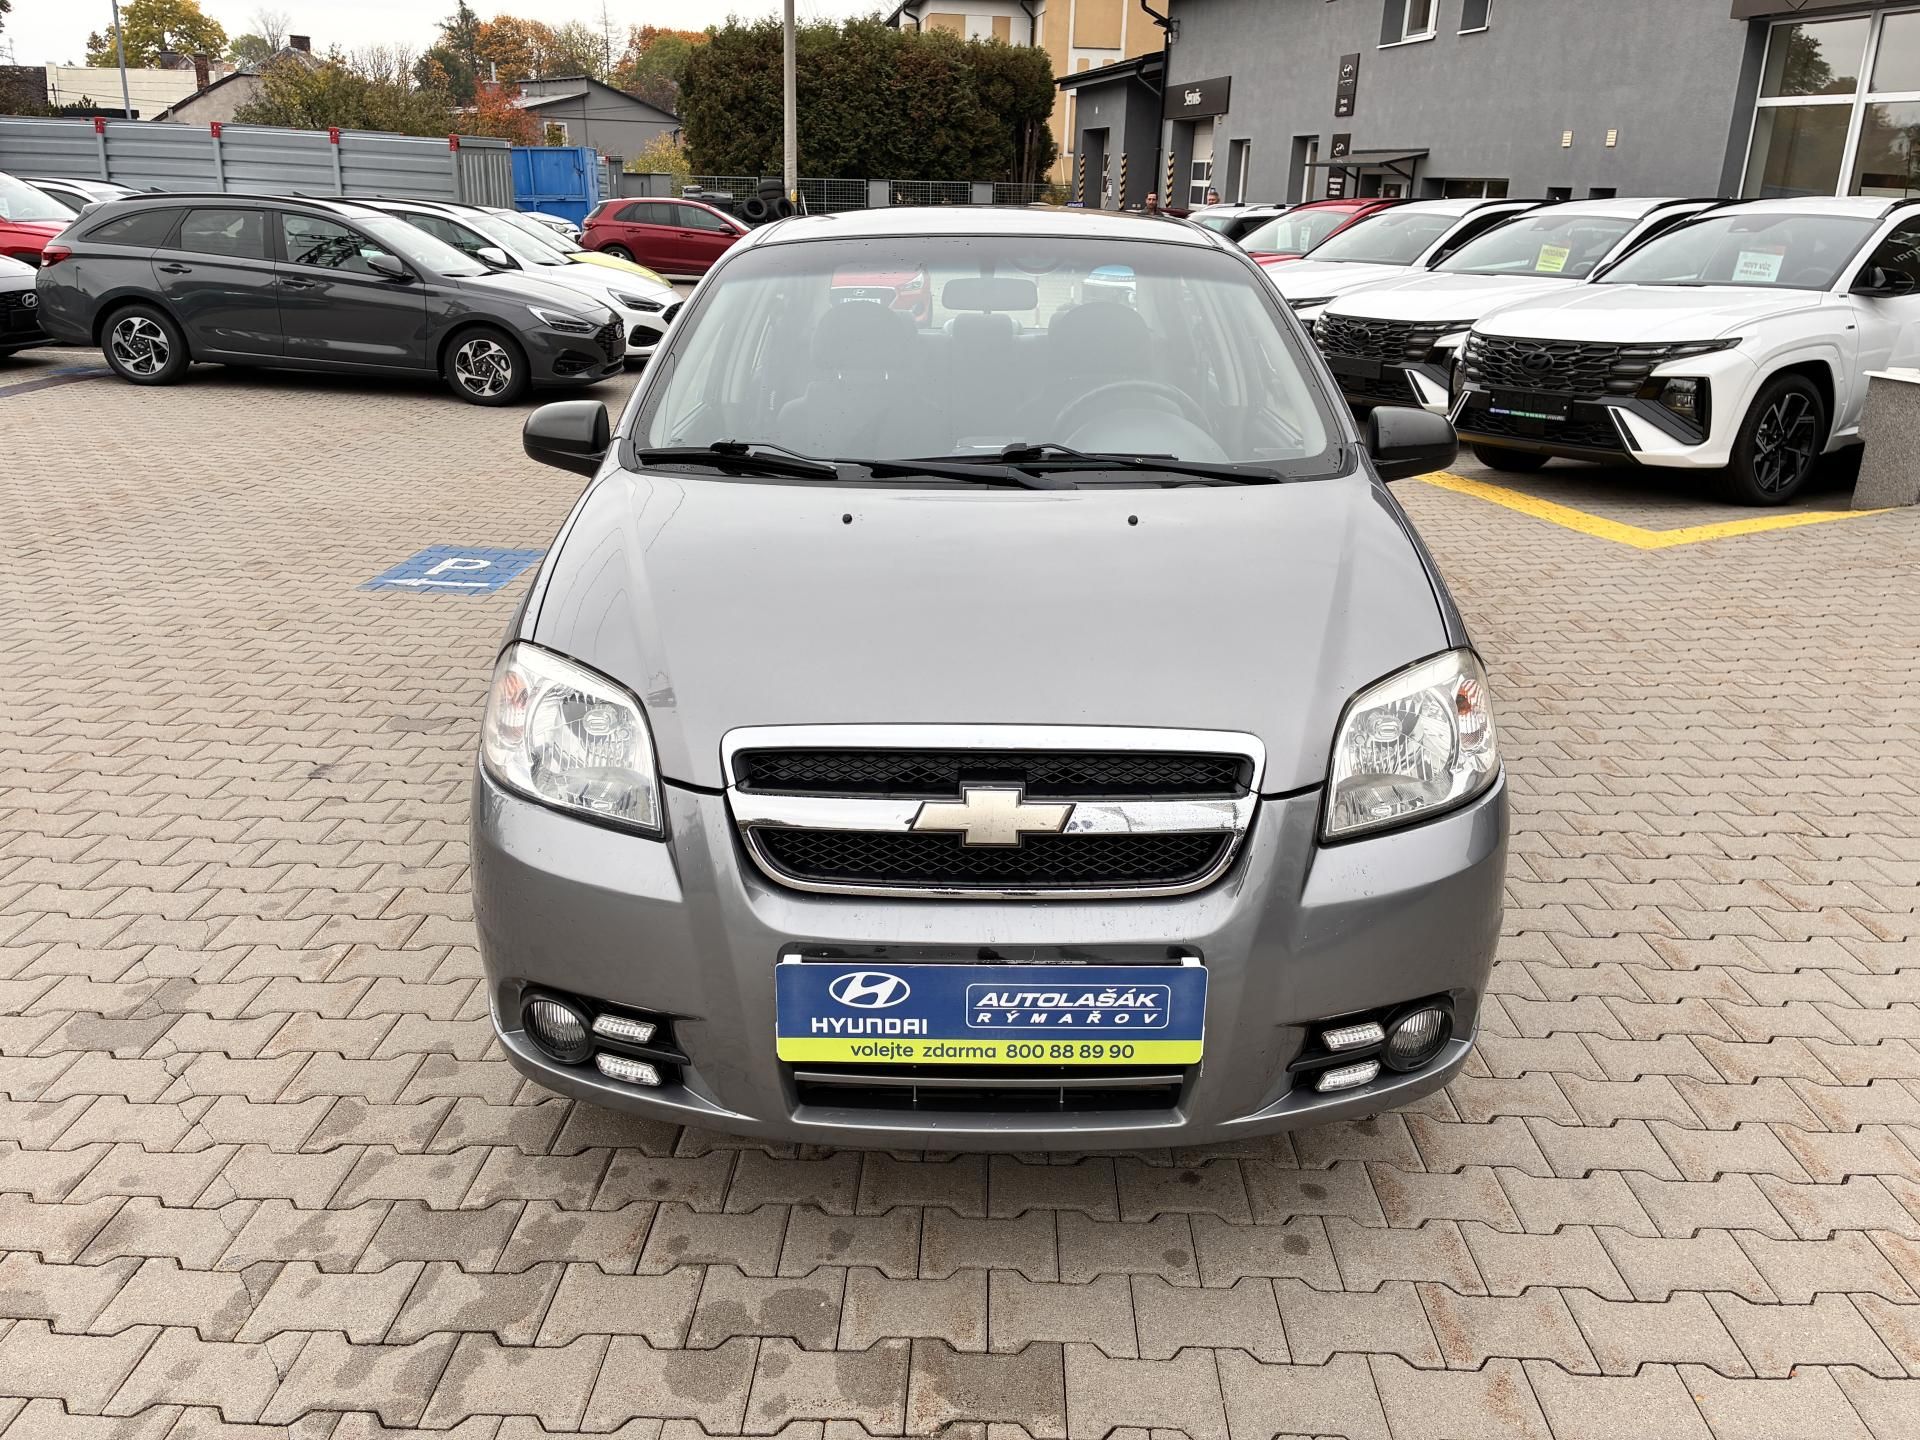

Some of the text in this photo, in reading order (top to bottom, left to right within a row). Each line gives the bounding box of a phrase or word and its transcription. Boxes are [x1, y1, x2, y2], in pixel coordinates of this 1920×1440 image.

[976, 988, 1159, 1008] AUTOLAŠÁK
[811, 1017, 928, 1035] HYUNDAI
[976, 1010, 1158, 1024] RÝMAŘOV
[850, 1041, 1135, 1060] volejte zdarma 800 88 89 90
